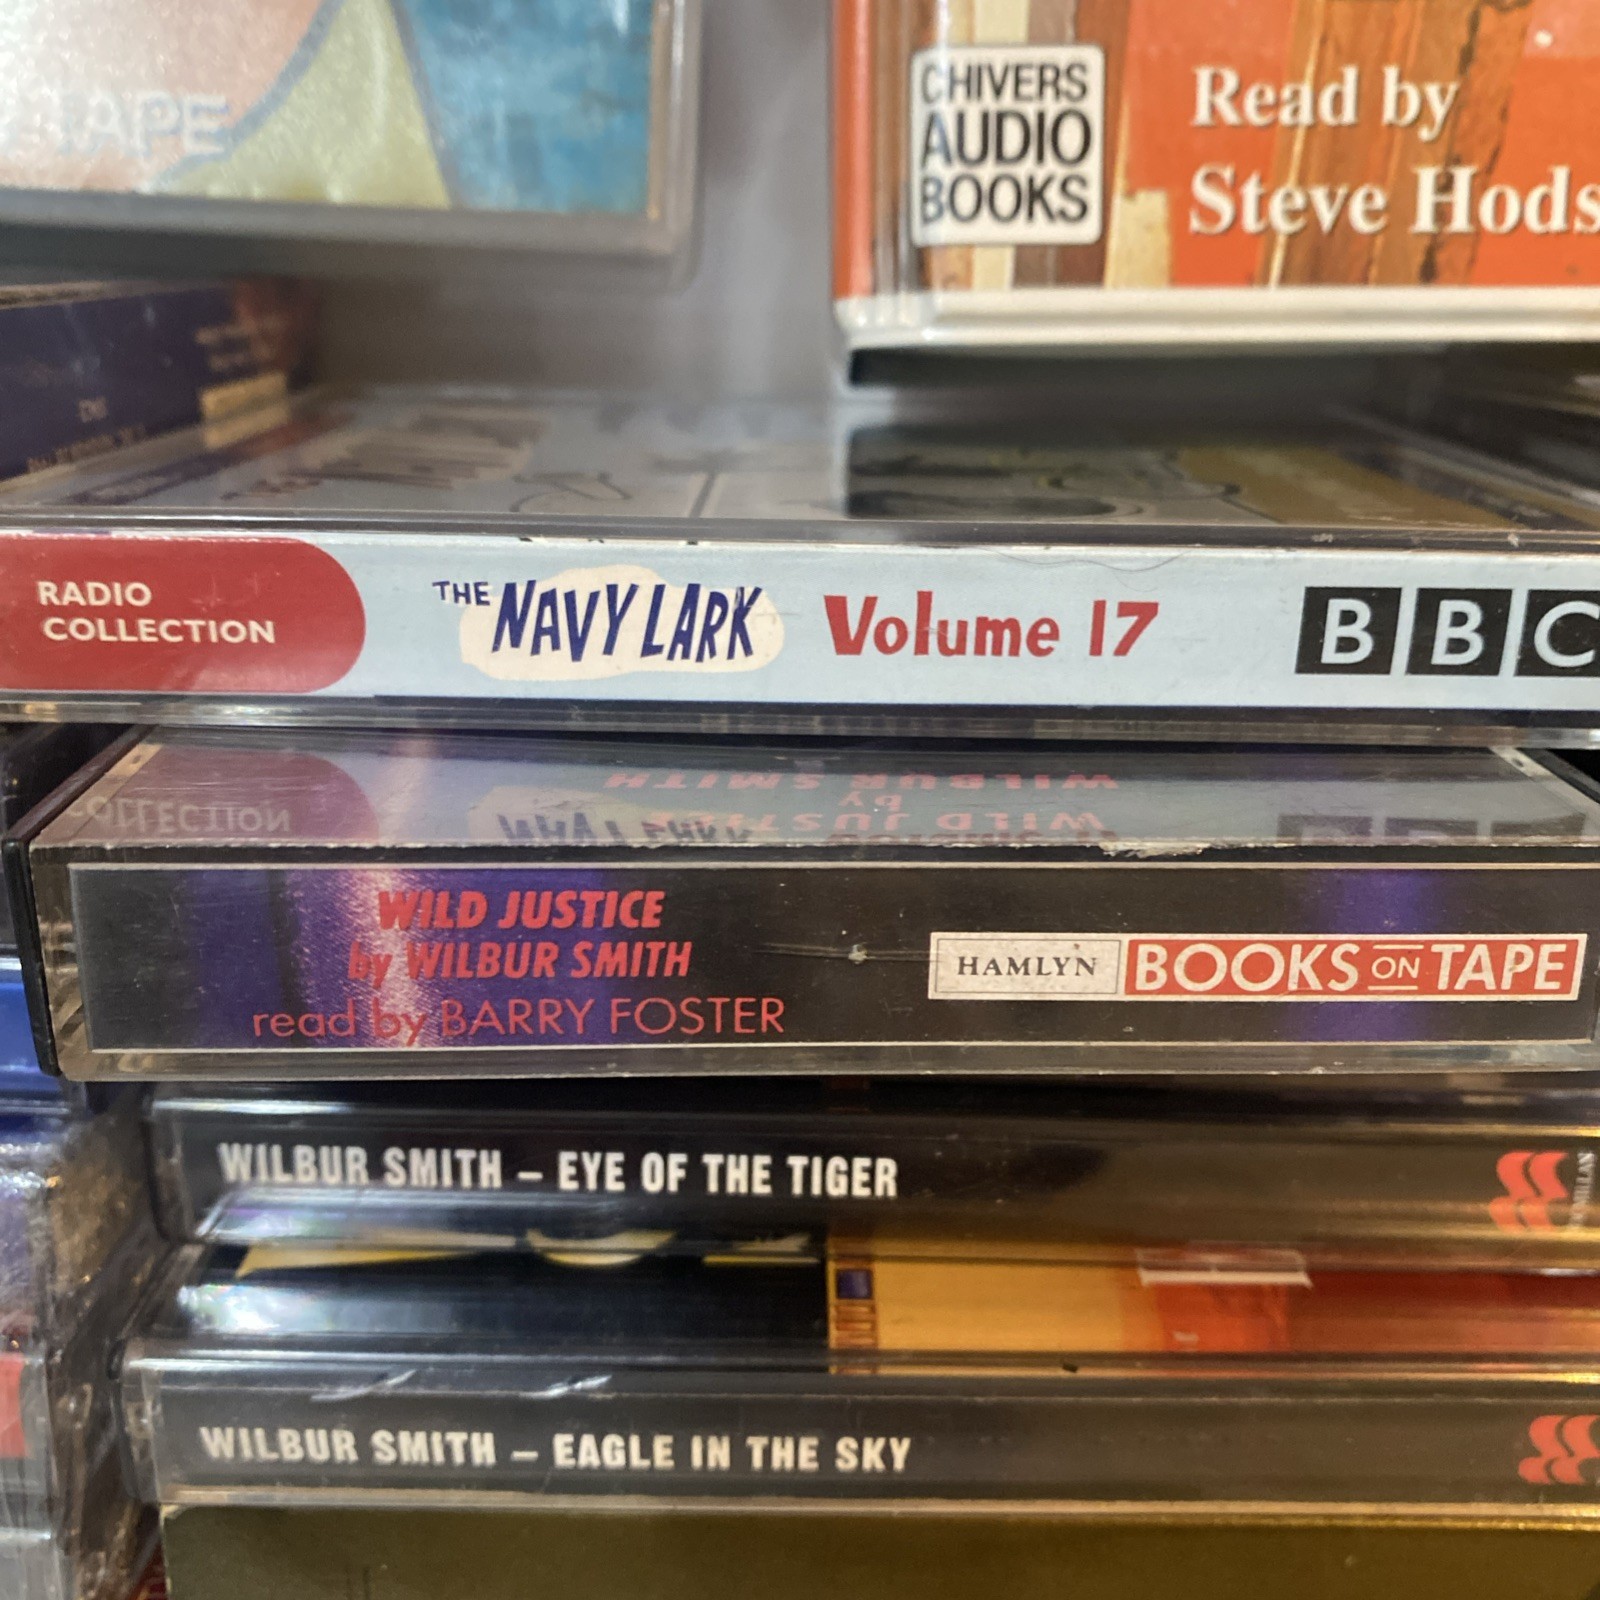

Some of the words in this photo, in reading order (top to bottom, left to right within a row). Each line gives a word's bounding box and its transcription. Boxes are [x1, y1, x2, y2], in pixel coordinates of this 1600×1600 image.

[922, 62, 1088, 103] CHIVERS
[1191, 65, 1359, 127] Read
[1381, 65, 1459, 142] by
[922, 108, 1092, 168] AUDIO
[922, 174, 1089, 226] BOOKS
[1189, 163, 1389, 235] Steve
[37, 581, 152, 606] RADIO
[43, 618, 275, 643] COLLECTION
[432, 581, 491, 606] THE
[491, 579, 640, 663] NAVY
[640, 582, 763, 663] LARK
[824, 590, 1060, 657] Volume
[1089, 600, 1159, 656] 17
[1320, 597, 1600, 668] BBC
[377, 890, 488, 930] WILD
[497, 890, 667, 930] JUSTICE
[348, 941, 393, 988] by
[406, 941, 558, 979] WILBUR
[571, 940, 693, 979] SMITH
[956, 956, 1098, 978] HAMLYN
[1135, 943, 1359, 992] BOOKS
[1371, 955, 1420, 980] ON
[1432, 943, 1568, 991] TAPE
[252, 997, 357, 1038] read
[371, 997, 427, 1047] by
[441, 997, 596, 1036] BARRY
[611, 996, 786, 1035] FOSTER
[218, 1142, 370, 1185] WILBUR
[382, 1146, 503, 1189] SMITH
[557, 1150, 627, 1192] EYE
[640, 1151, 689, 1193] OF
[701, 1153, 773, 1195] THE
[786, 1154, 900, 1198] TIGER
[198, 1426, 360, 1463] WILBUR
[369, 1429, 497, 1467] SMITH
[551, 1432, 676, 1471] EAGLE
[690, 1434, 732, 1472] IN
[745, 1435, 821, 1473] THE
[834, 1435, 913, 1473] SKY
